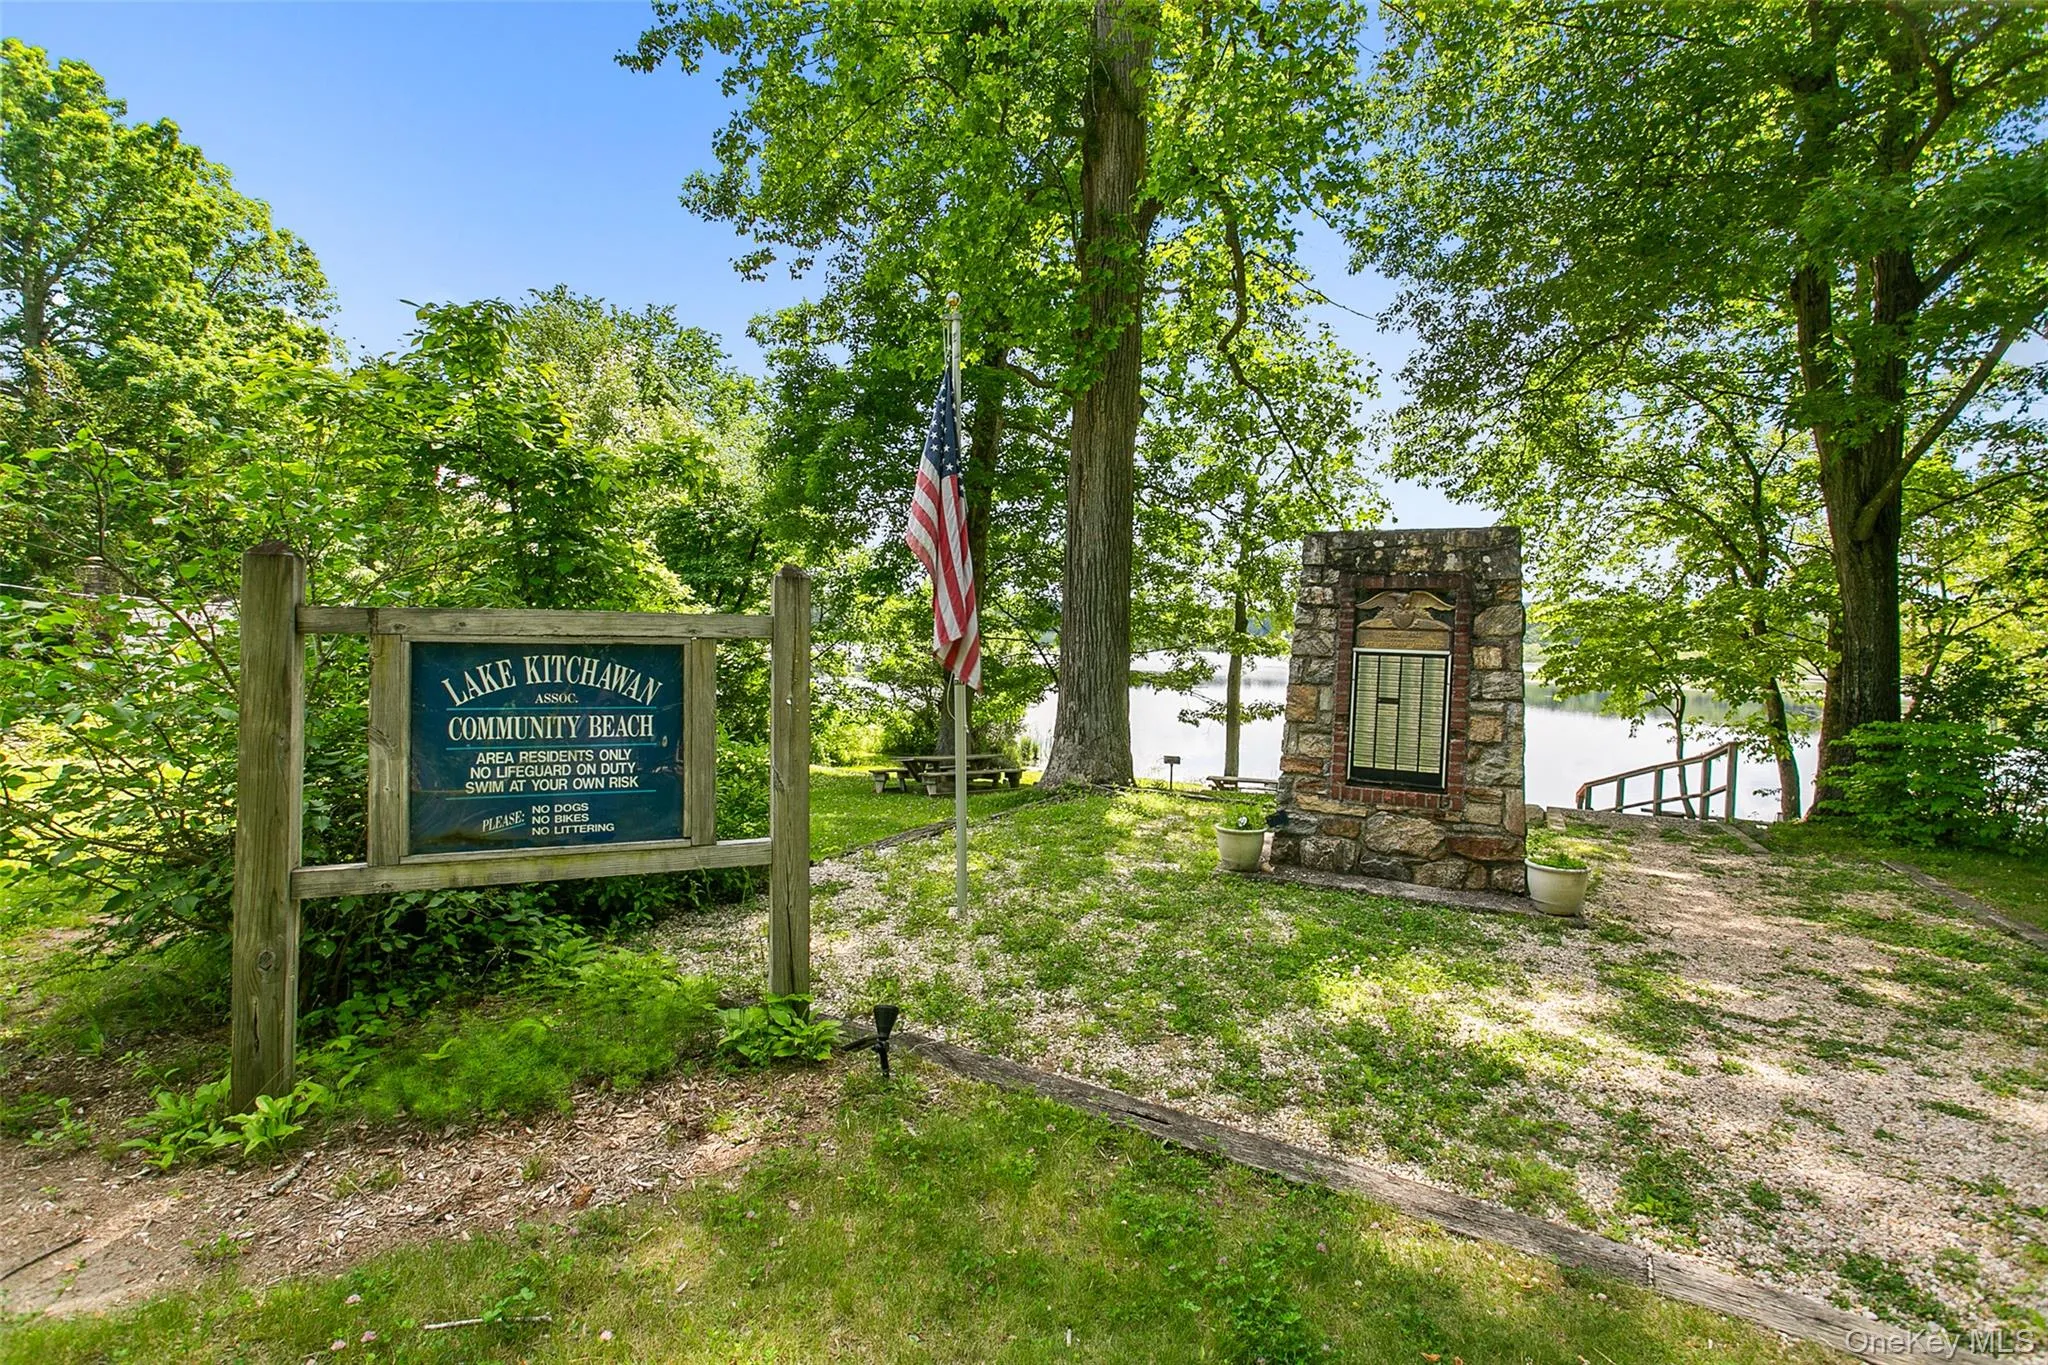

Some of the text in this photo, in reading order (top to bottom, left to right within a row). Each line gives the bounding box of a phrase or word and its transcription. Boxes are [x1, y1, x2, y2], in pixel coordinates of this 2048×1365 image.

[441, 654, 663, 707] LAKE KITCHAWAN
[534, 692, 579, 704] ASSOC.
[448, 714, 654, 740] COMMUNITY BEACH
[475, 748, 632, 765] AREA RESIDENTS ONLY
[470, 762, 636, 780] NO LIFEGUARD ON DUTY
[465, 775, 639, 794] SWIM AT YOUR OWN RISK
[531, 802, 589, 815] NO DOGS
[482, 810, 525, 832] PLEASE:
[531, 813, 589, 826] NO BIKES
[531, 823, 615, 837] NO LITTERING
